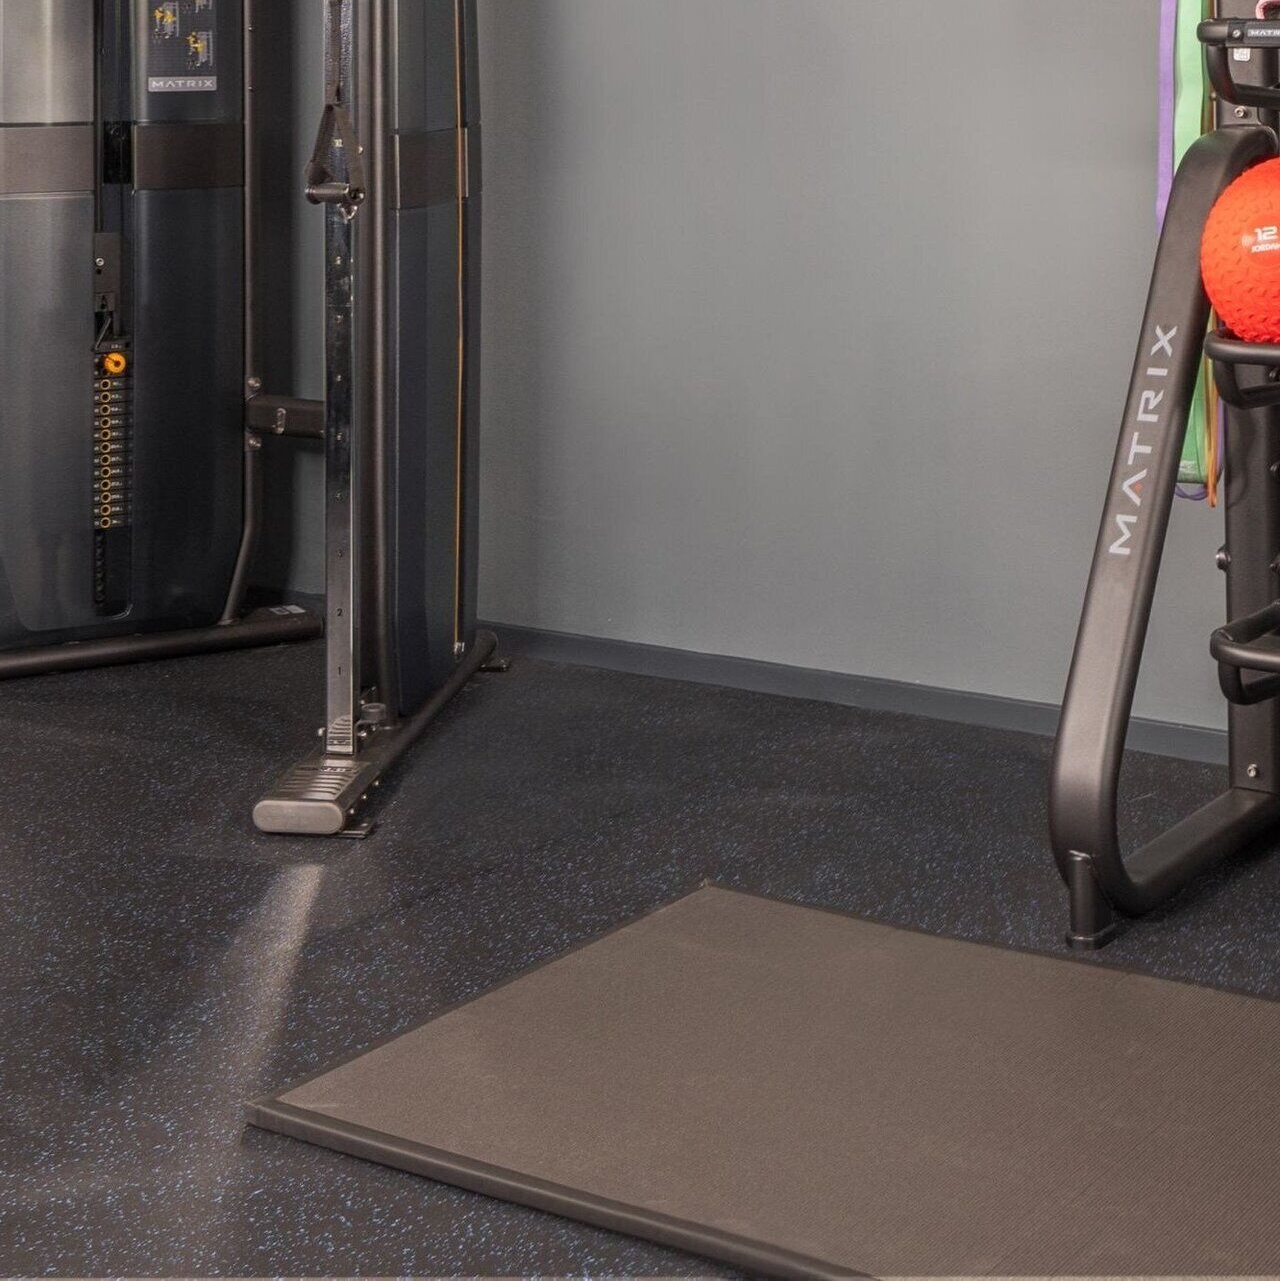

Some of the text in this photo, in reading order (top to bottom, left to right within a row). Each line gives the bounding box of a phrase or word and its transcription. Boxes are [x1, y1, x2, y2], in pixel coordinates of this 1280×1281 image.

[151, 79, 213, 88] MATRIX
[1254, 225, 1279, 241] 12
[1108, 324, 1178, 556] MATRIX
